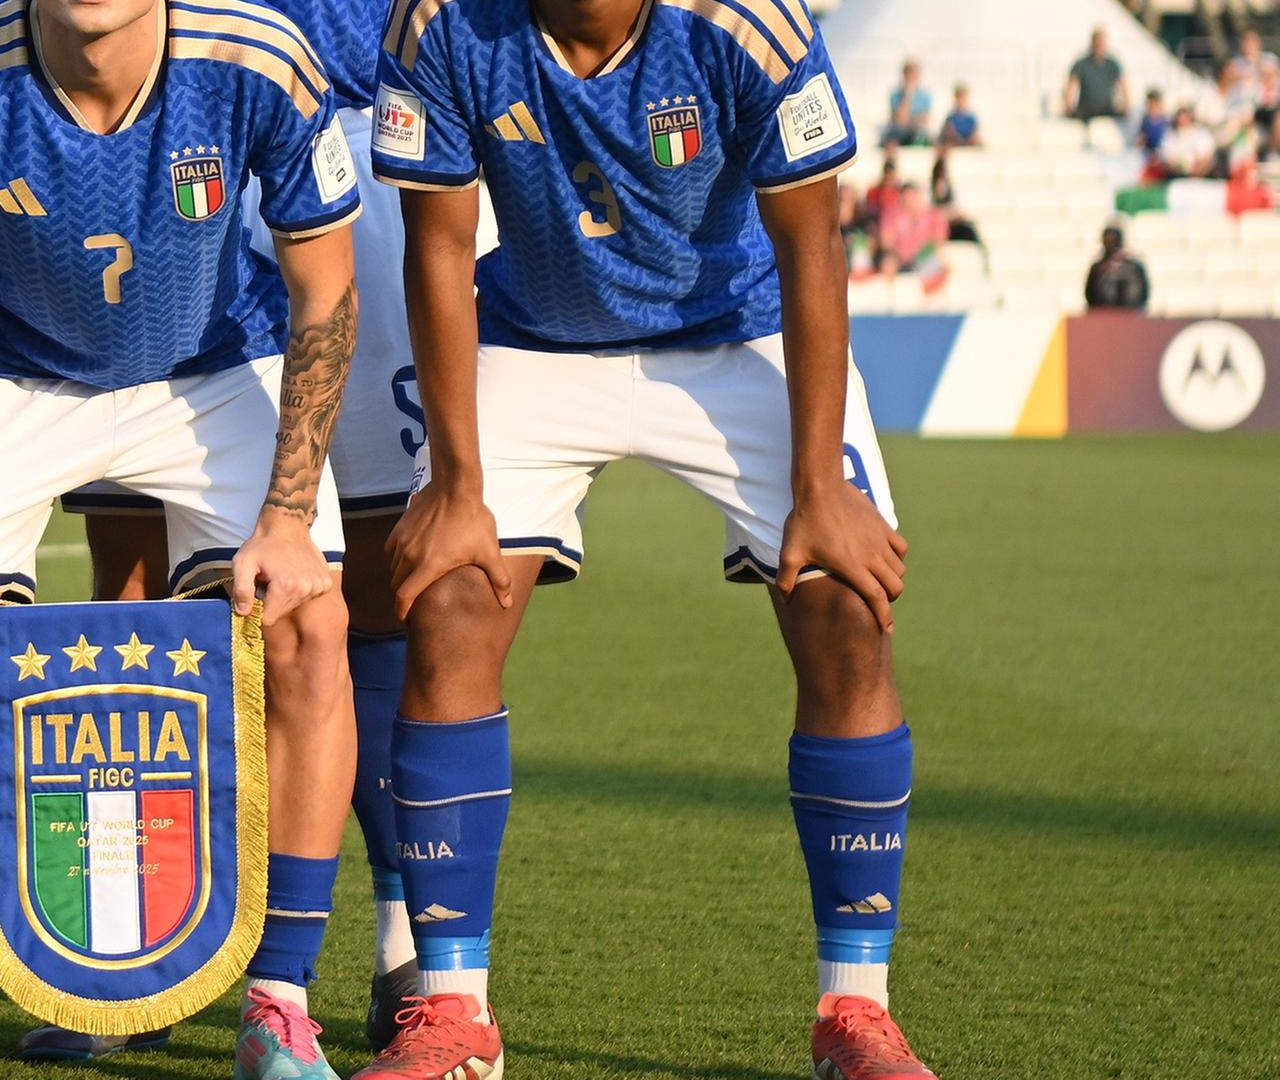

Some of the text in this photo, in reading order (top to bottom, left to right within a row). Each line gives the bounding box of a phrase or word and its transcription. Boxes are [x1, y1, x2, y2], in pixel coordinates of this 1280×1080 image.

[378, 104, 416, 128] U17
[651, 111, 696, 131] ITALIA
[792, 100, 823, 125] UNITES
[175, 161, 219, 181] ITALIA
[572, 160, 622, 238] 3
[83, 233, 134, 305] 7
[31, 711, 191, 765] ITALIA
[89, 767, 134, 788] FIGC
[50, 822, 76, 832] FIFA
[103, 819, 146, 831] WORLD
[150, 818, 175, 829] CUP
[77, 836, 118, 848] QATAR
[394, 840, 454, 859] TALIA
[831, 832, 902, 851] ITALIA
[67, 865, 81, 877] 27
